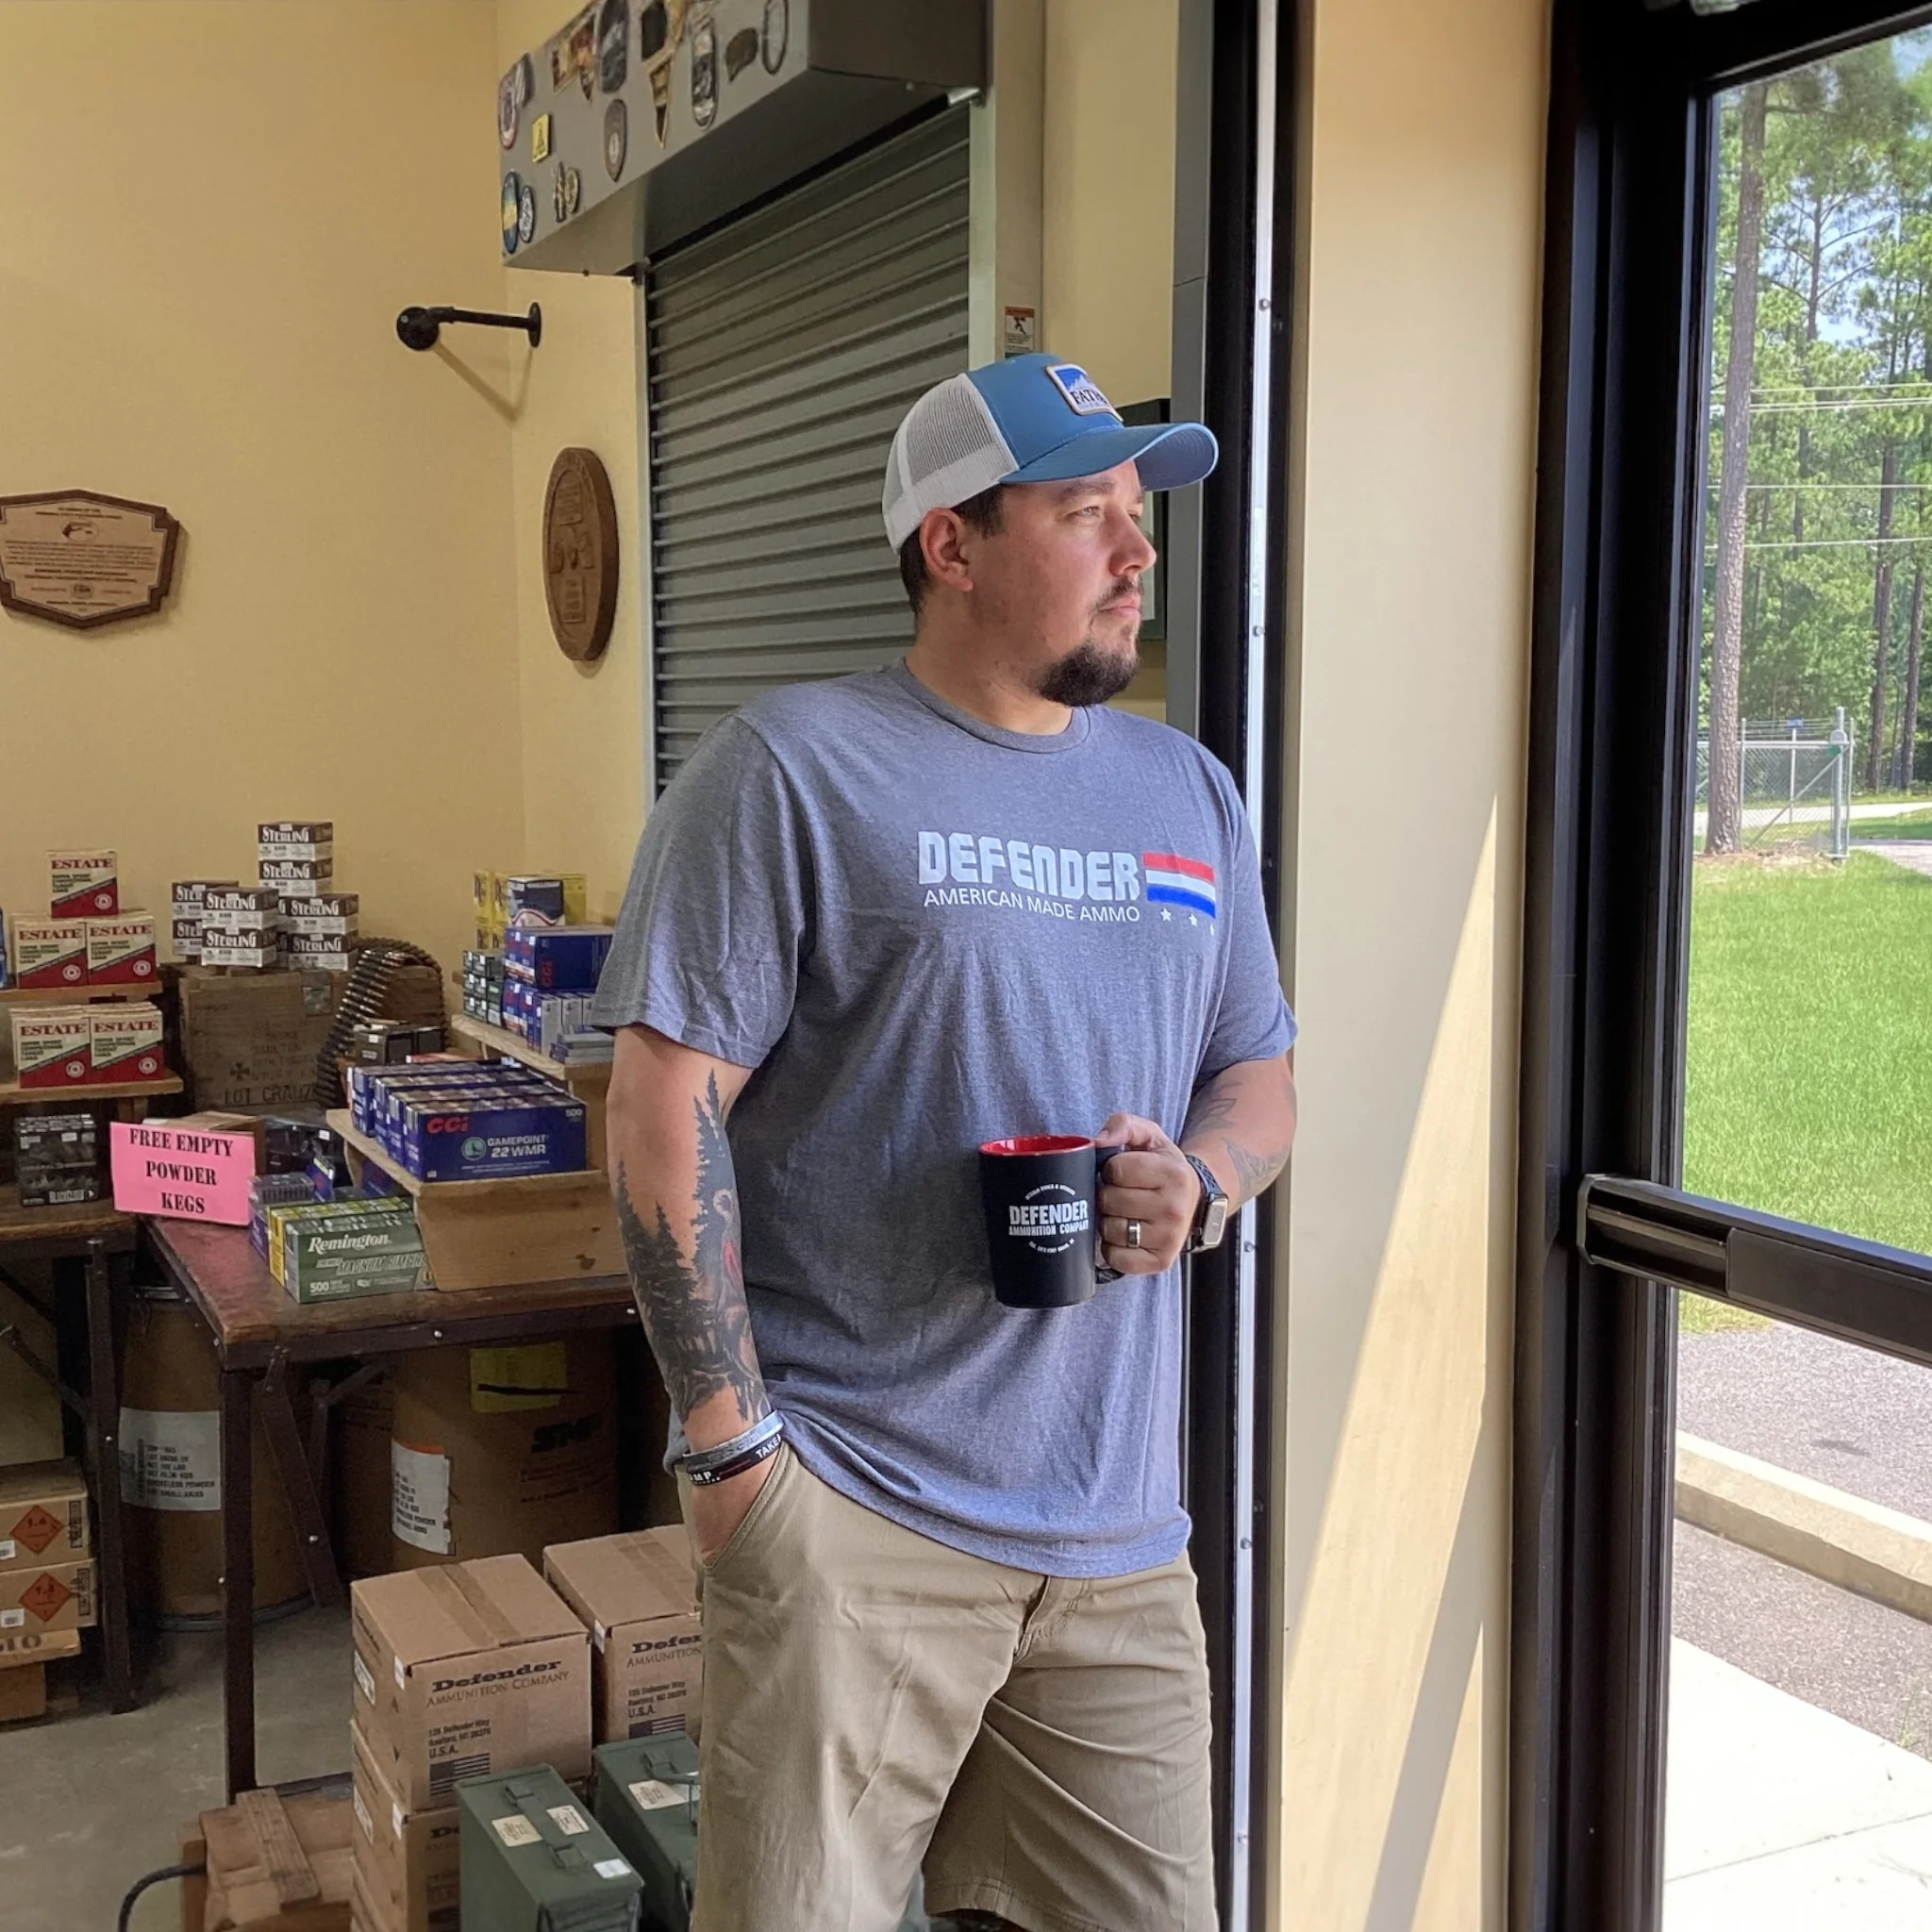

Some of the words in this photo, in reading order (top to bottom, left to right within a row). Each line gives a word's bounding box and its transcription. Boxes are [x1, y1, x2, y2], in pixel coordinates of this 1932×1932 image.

[261, 825, 309, 842] STERLING
[51, 858, 113, 870] ESTATE
[262, 861, 310, 878] STERLING
[918, 830, 1141, 901] DEFENDER
[206, 892, 257, 910] STERLING
[291, 900, 340, 917] STERLING
[924, 889, 1024, 908] AMERICAN
[1027, 895, 1075, 920] MADE
[1079, 906, 1141, 923] AMMO
[19, 928, 83, 941] ESTATE
[90, 924, 152, 937] ESTATE
[206, 929, 258, 948] STERLING
[20, 1023, 86, 1037] ESTATE
[94, 1021, 158, 1033] ESTATE
[129, 1128, 172, 1150] FREE
[176, 1134, 234, 1157] EMPTY
[487, 1134, 546, 1147] GAMEPOINT
[491, 1148, 509, 1158] 22
[511, 1144, 546, 1158] WMR
[145, 1160, 217, 1186] POWDER
[160, 1191, 206, 1214] KEGS
[1008, 1199, 1089, 1225] DEFENDER
[1008, 1224, 1057, 1236] AMMUNITION
[308, 1233, 390, 1255] Remington
[309, 1281, 330, 1293] 500
[432, 1660, 562, 1692] Defender
[425, 1682, 508, 1708] AMMUNITION
[512, 1671, 571, 1690] COMPANY
[428, 1744, 459, 1759] U.S.A.
